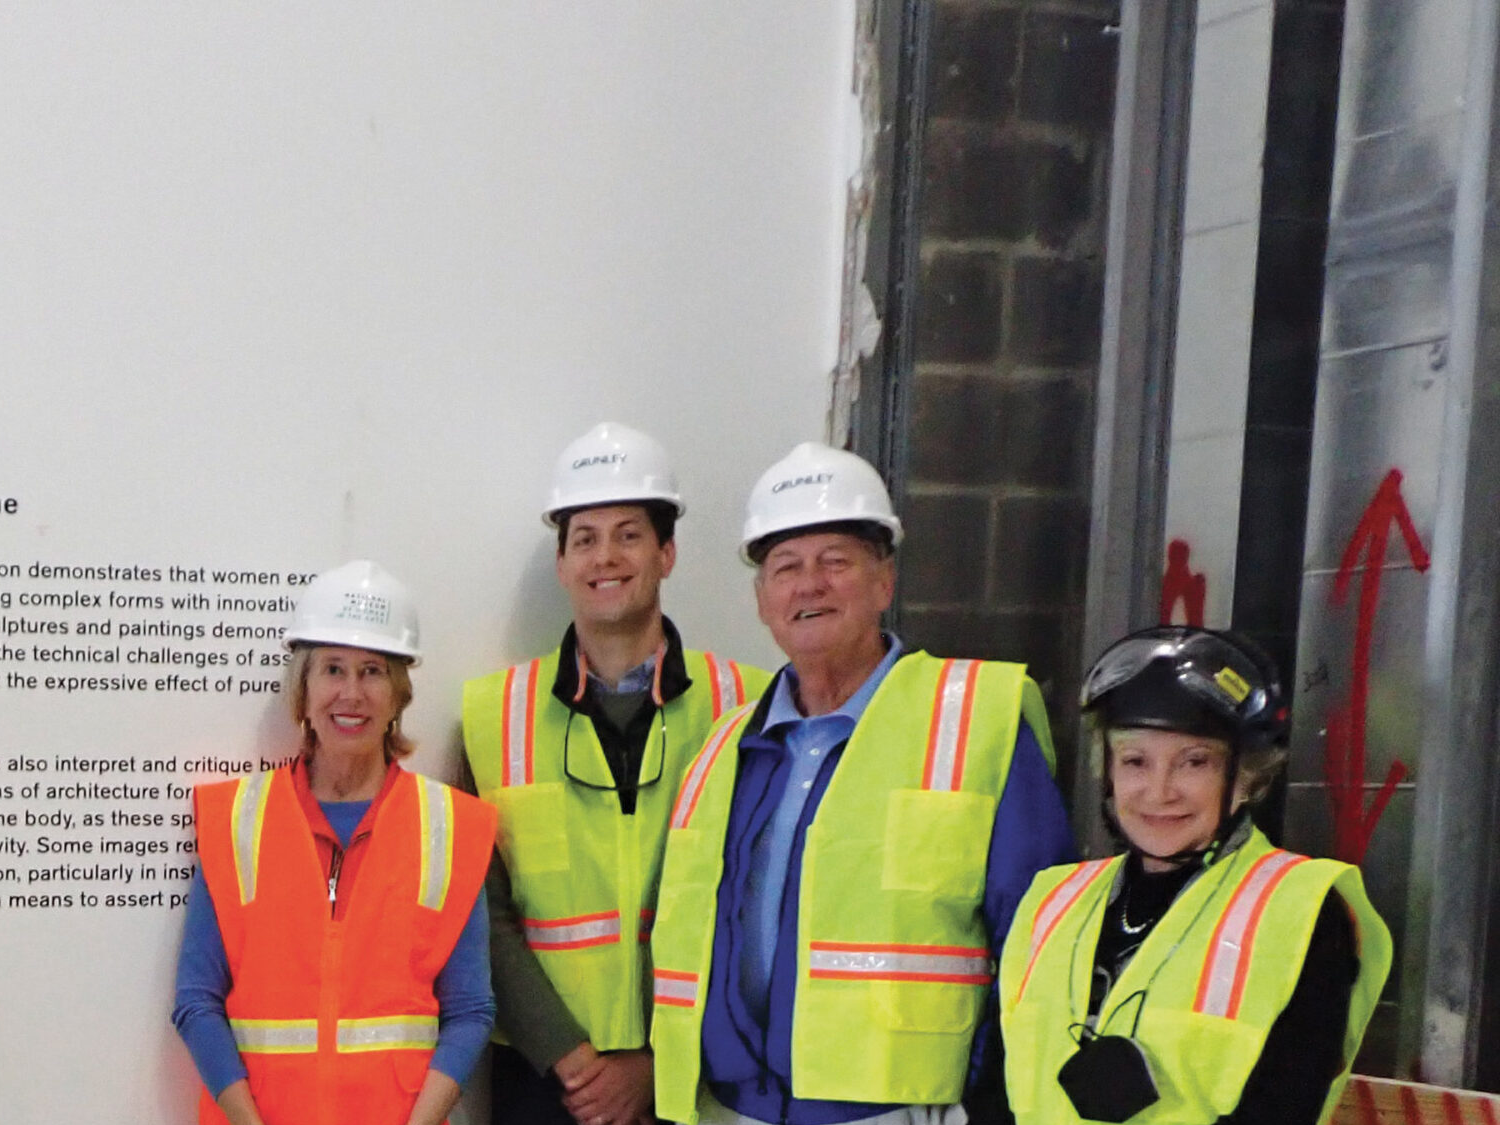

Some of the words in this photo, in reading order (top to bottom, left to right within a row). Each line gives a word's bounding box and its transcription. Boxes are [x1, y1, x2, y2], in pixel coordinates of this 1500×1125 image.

[28, 561, 161, 582] demonstrates
[169, 566, 205, 583] that
[212, 571, 279, 584] women
[19, 590, 101, 610] complex
[110, 591, 164, 609] forms
[172, 593, 209, 610] with
[217, 594, 298, 612] innovativ
[76, 619, 111, 635] and
[119, 620, 205, 641] paintings
[212, 622, 289, 639] demons
[33, 645, 119, 663] technical
[127, 647, 229, 668] challenges
[236, 649, 254, 666] of
[260, 654, 291, 666] ass
[7, 672, 37, 689] the
[45, 674, 148, 693] expressive
[155, 675, 208, 692] effect
[215, 676, 232, 692] of
[240, 680, 280, 695] pure
[8, 755, 48, 772] also
[56, 755, 136, 775] interpret
[142, 756, 176, 772] and
[184, 756, 252, 776] critique
[21, 782, 40, 799] of
[46, 782, 159, 799] architecture
[167, 783, 191, 800] for
[25, 809, 76, 830] body,
[83, 814, 104, 827] as
[111, 810, 164, 826] these
[37, 836, 93, 854] Some
[101, 837, 168, 857] images
[28, 864, 133, 885] particularly
[141, 864, 156, 880] in
[164, 864, 195, 880] inst
[9, 895, 73, 908] means
[80, 891, 98, 907] to
[105, 891, 163, 907] assert
